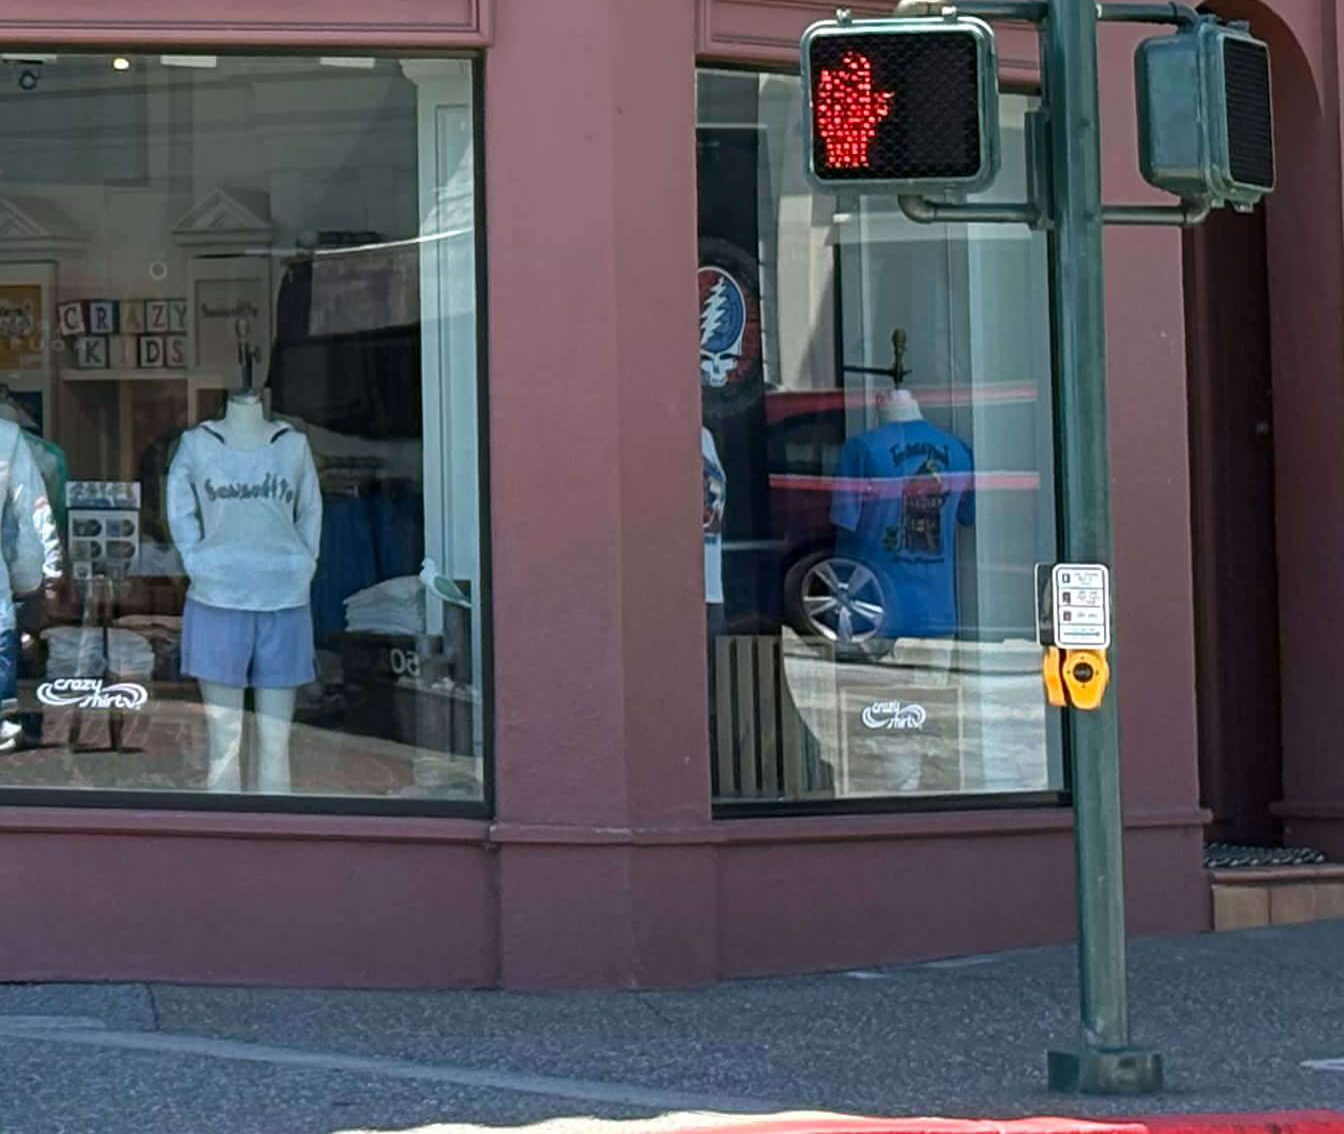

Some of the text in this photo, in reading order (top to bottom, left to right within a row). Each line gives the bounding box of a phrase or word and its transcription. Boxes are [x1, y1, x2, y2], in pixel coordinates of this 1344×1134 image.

[62, 303, 188, 331] CRAZY
[84, 339, 184, 364] KIDS
[54, 678, 103, 693] crazy
[79, 692, 137, 709] shirts
[871, 700, 901, 714] crazy
